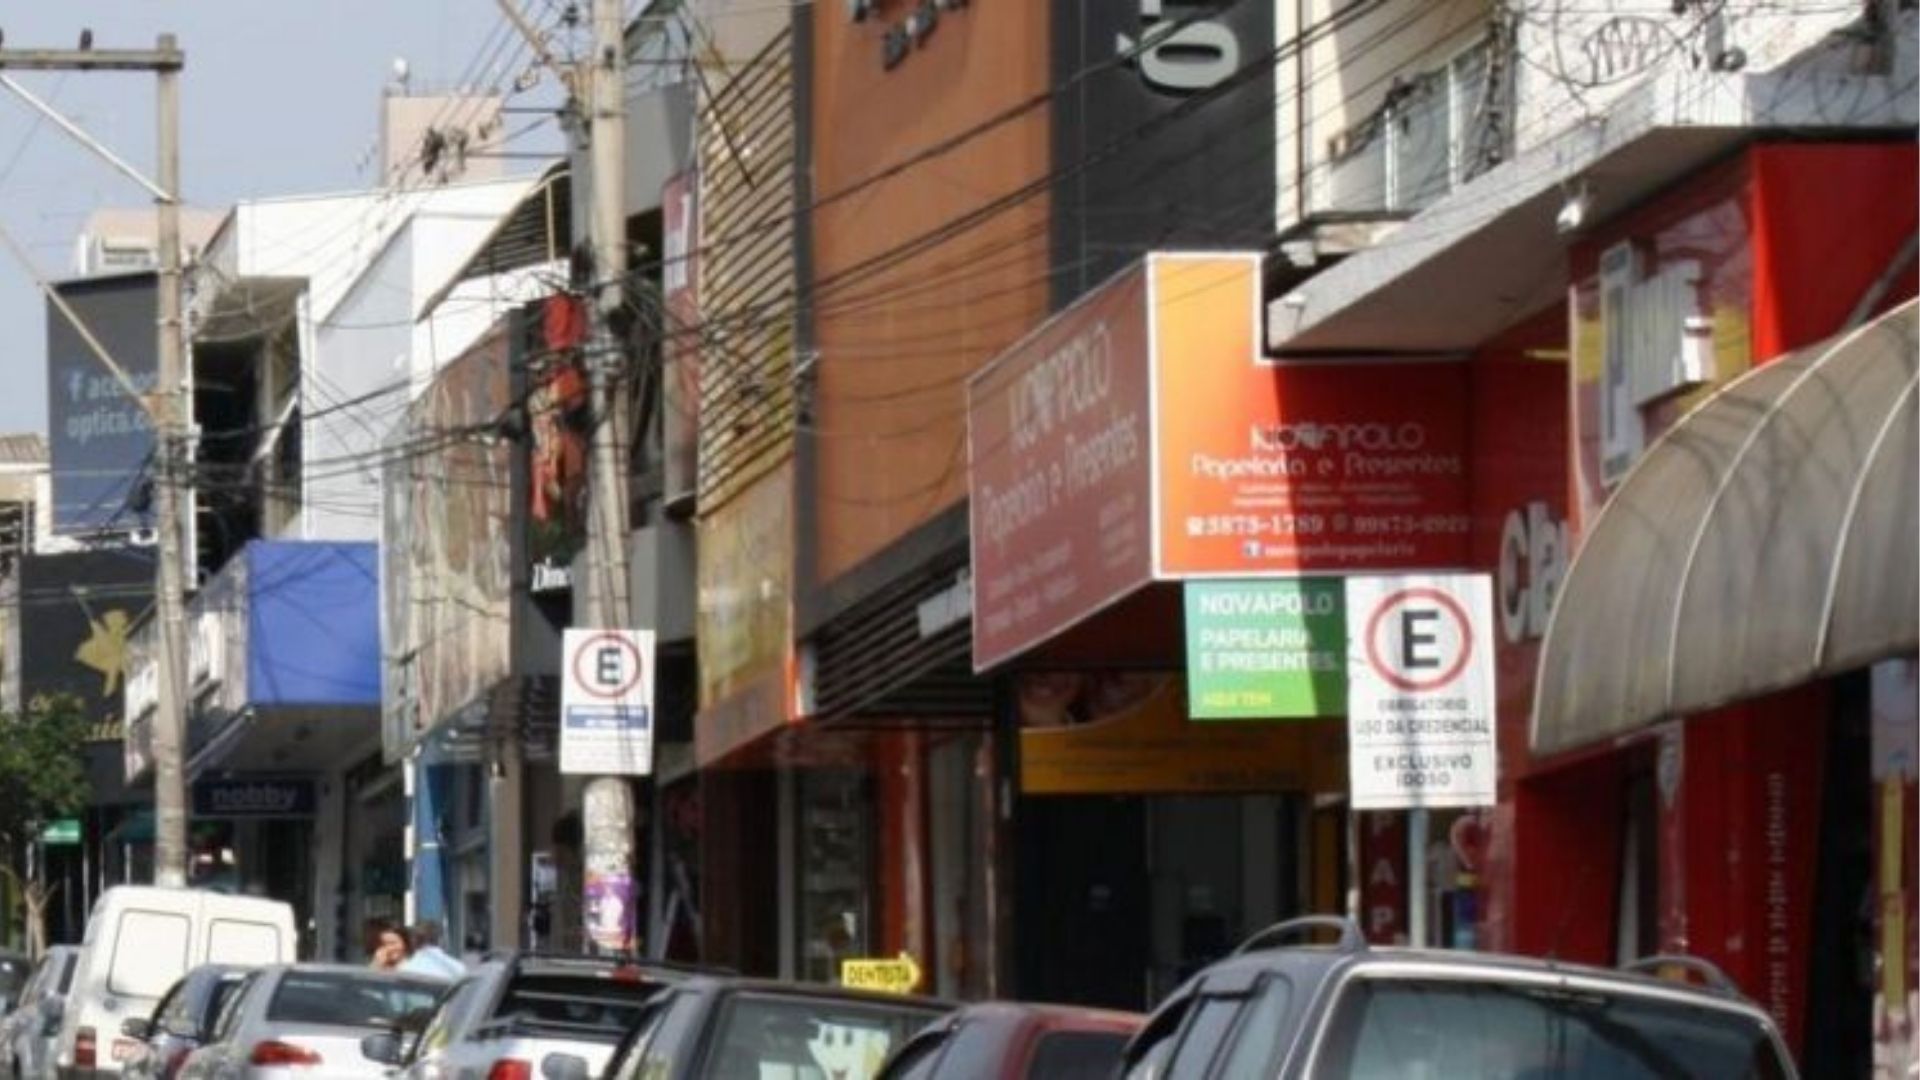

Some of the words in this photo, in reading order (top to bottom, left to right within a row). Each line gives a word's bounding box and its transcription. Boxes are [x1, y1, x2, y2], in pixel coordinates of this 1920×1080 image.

[1191, 451, 1307, 479] Papelaria
[1316, 456, 1335, 476] e
[1343, 451, 1462, 477] Presentes
[1200, 592, 1334, 615] NOVAPOLO
[1200, 628, 1314, 648] PAPELARIA
[1401, 610, 1439, 668] E
[596, 647, 622, 685] E
[1386, 718, 1404, 734] DA
[1406, 718, 1490, 734] CREDENCIAL
[1374, 753, 1472, 771] EXCLUSIVO
[1396, 771, 1451, 787] IDOSO
[212, 782, 298, 807] nobby
[848, 965, 912, 984] DENTISTA
